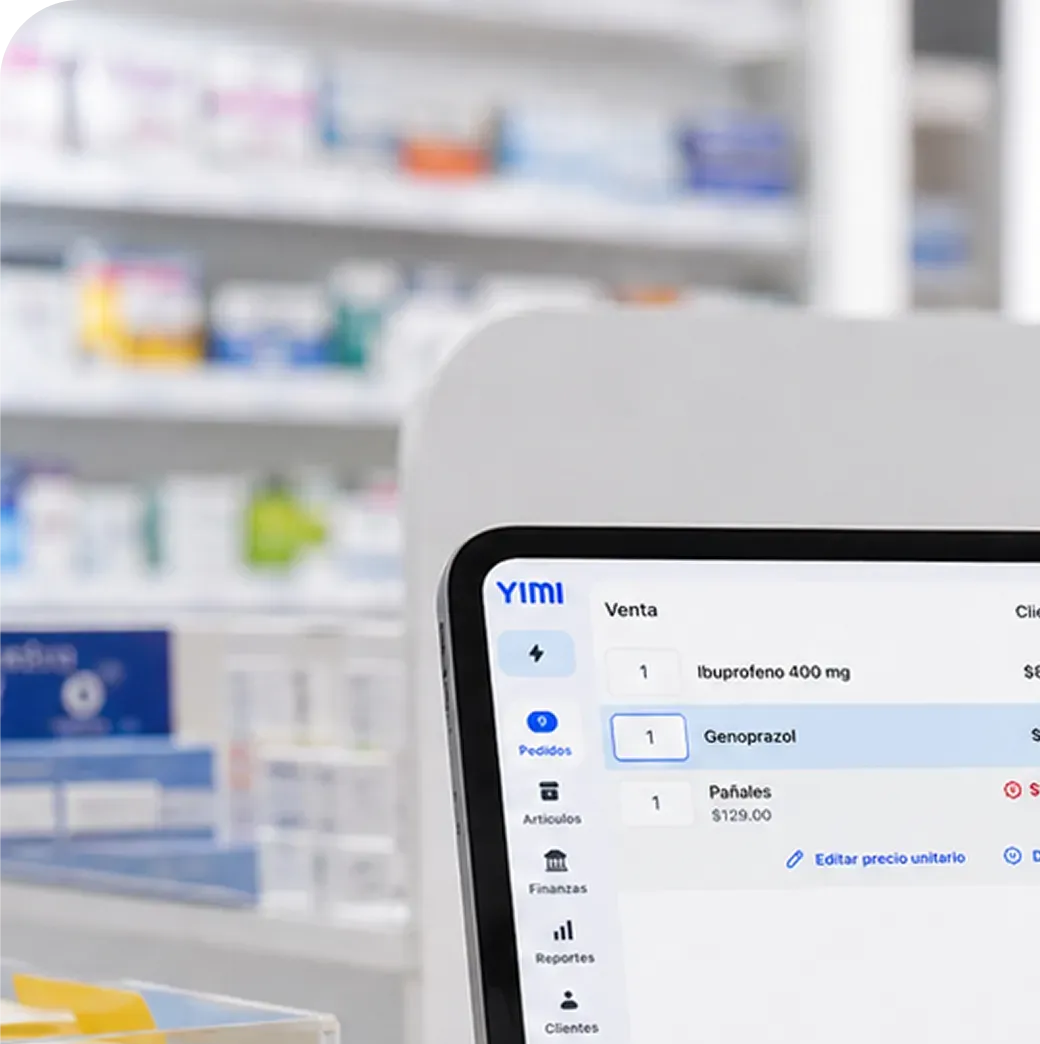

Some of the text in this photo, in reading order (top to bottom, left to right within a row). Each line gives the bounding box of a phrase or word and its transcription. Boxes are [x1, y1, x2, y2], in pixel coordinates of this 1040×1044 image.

[496, 581, 564, 604] YIMI
[604, 601, 659, 618] Venta
[639, 664, 648, 679] 1
[696, 664, 786, 682] Ibuprofeno
[788, 664, 821, 679] 400
[825, 666, 851, 682] mg
[645, 729, 655, 744] 1
[703, 729, 797, 746] Genoprazol
[518, 744, 573, 757] Pedidos
[651, 795, 661, 810] 1
[708, 783, 773, 799] Pañales
[711, 807, 773, 823] $129.00
[814, 851, 967, 869] Editar precio unitario
[528, 882, 588, 896] Finanzas
[535, 952, 596, 965] Reportes
[544, 1021, 600, 1035] Clientes
